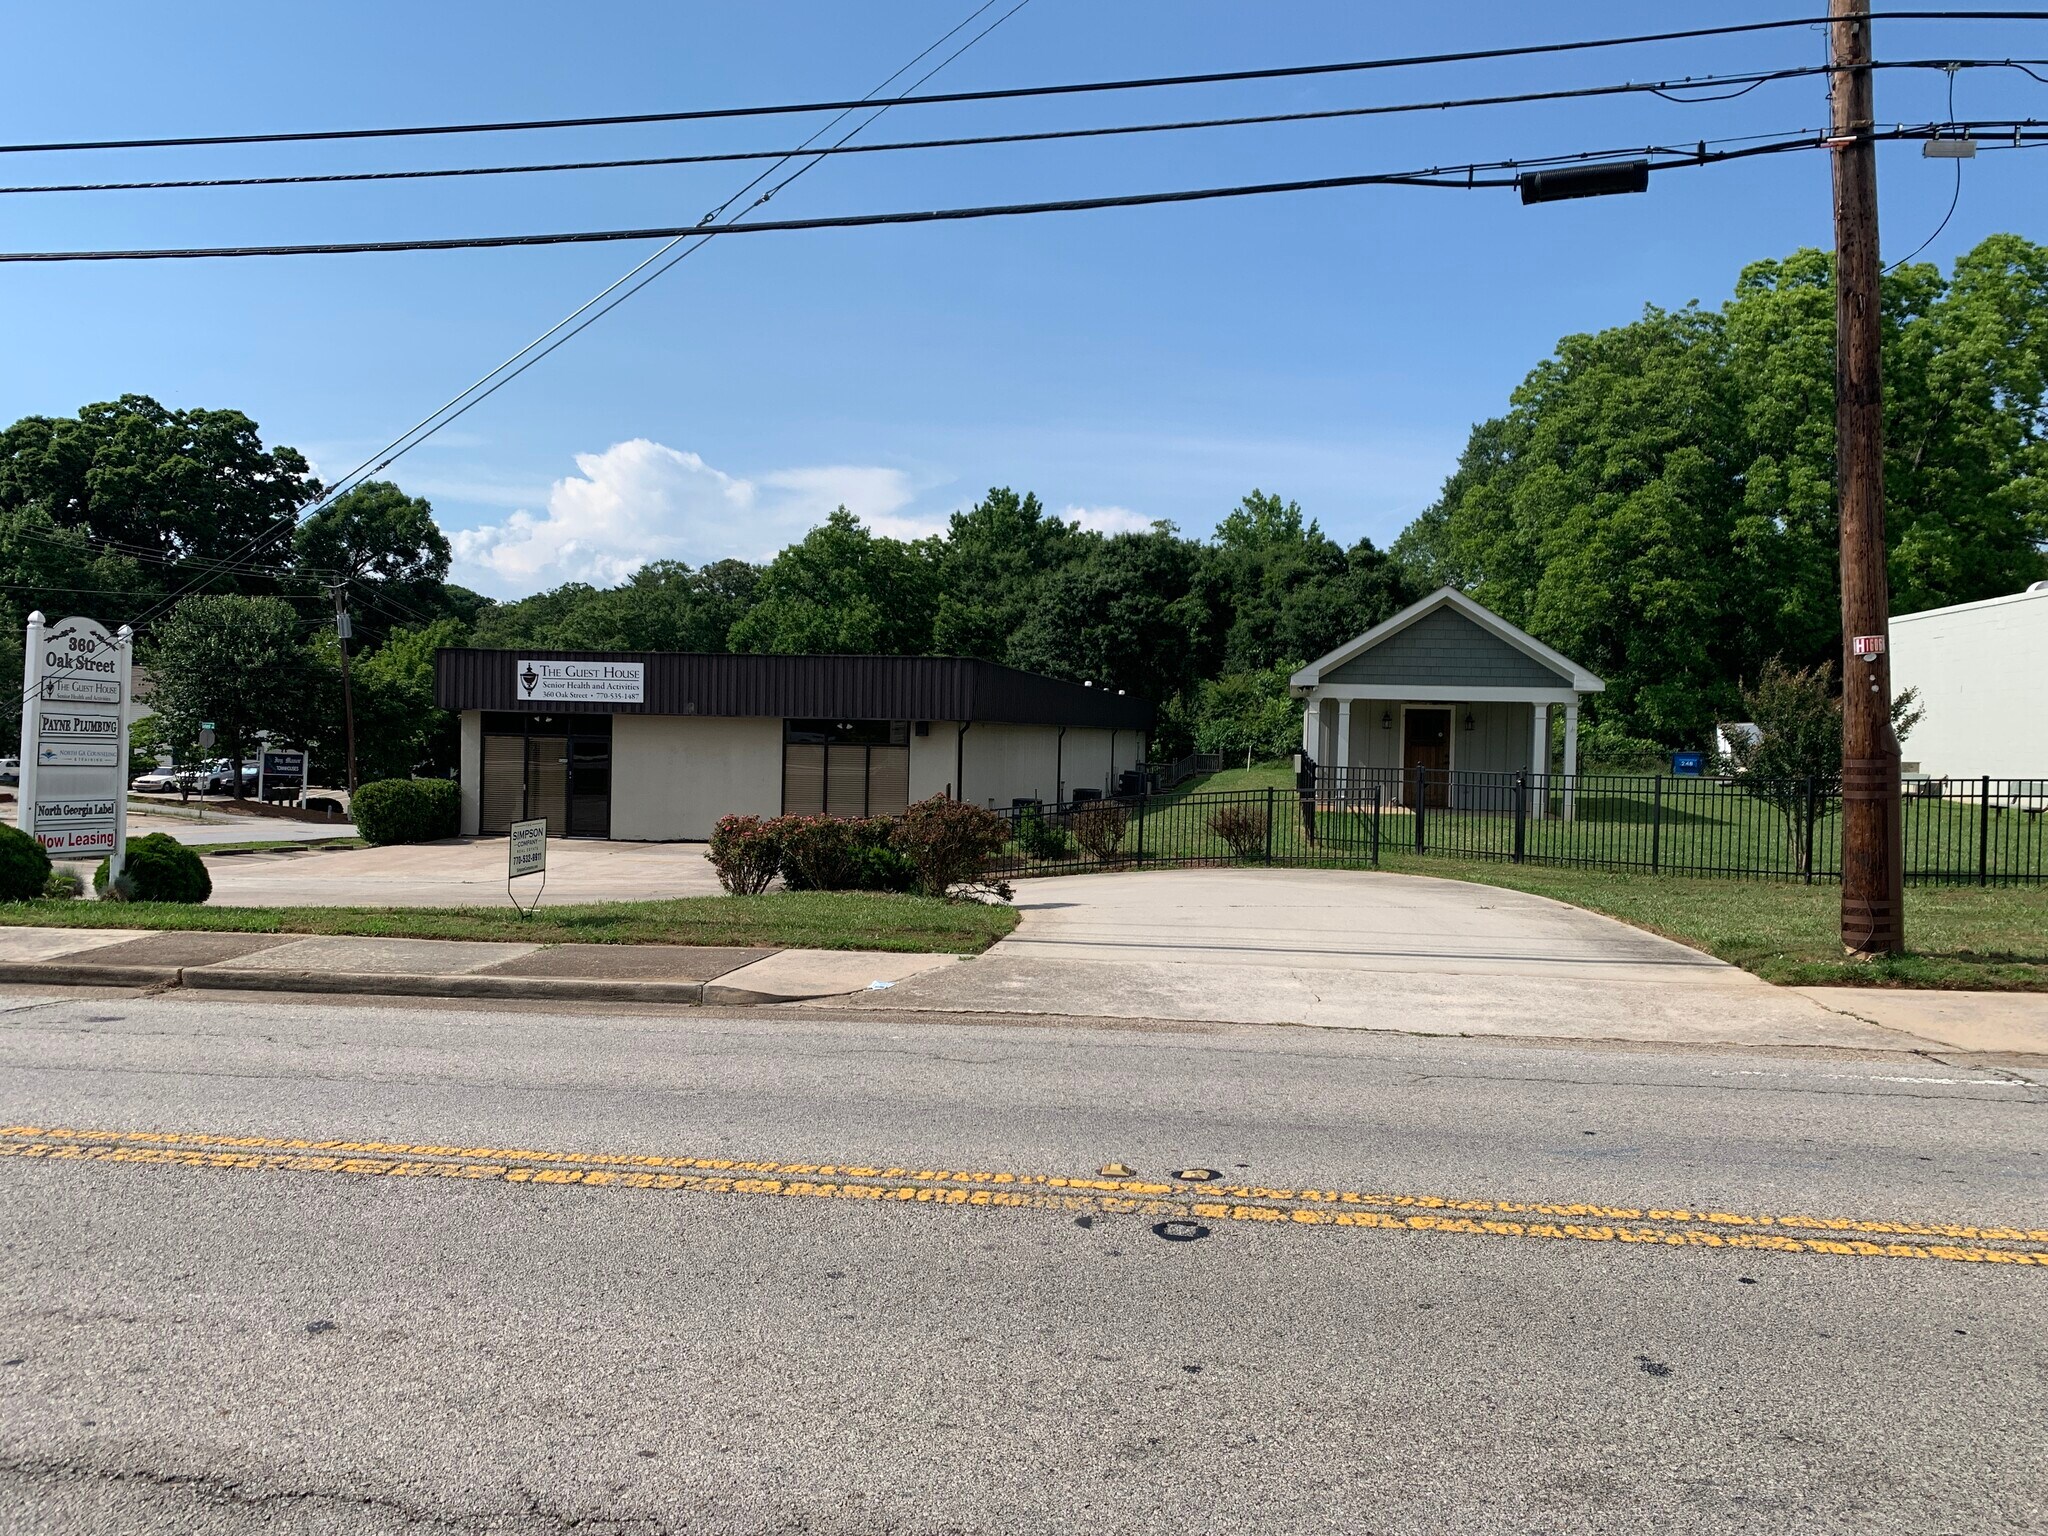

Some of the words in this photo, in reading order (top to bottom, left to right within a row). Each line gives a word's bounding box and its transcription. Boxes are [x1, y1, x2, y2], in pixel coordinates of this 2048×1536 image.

[69, 637, 95, 653] 360
[46, 652, 73, 669] Oak
[76, 655, 115, 673] Street
[540, 665, 561, 677] THE
[565, 665, 600, 678] GUEST
[604, 666, 640, 679] HOUSE
[57, 680, 70, 691] THE
[72, 681, 94, 692] GUEST
[96, 683, 117, 694] HOUSE
[542, 681, 565, 689] Senior
[567, 682, 591, 690] Health
[606, 683, 640, 691] Activities
[542, 690, 554, 698] 360
[569, 691, 588, 699] Street
[596, 692, 640, 700] 770-535-1487
[42, 717, 71, 732] PAYNE
[73, 717, 117, 733] PLUMBING
[38, 804, 62, 817] North
[63, 803, 93, 817] Georgia
[94, 803, 114, 815] Label
[37, 833, 64, 848] Now
[68, 830, 113, 847] Leasing
[512, 827, 543, 841] SIMPSON
[517, 839, 538, 848] COMPANY
